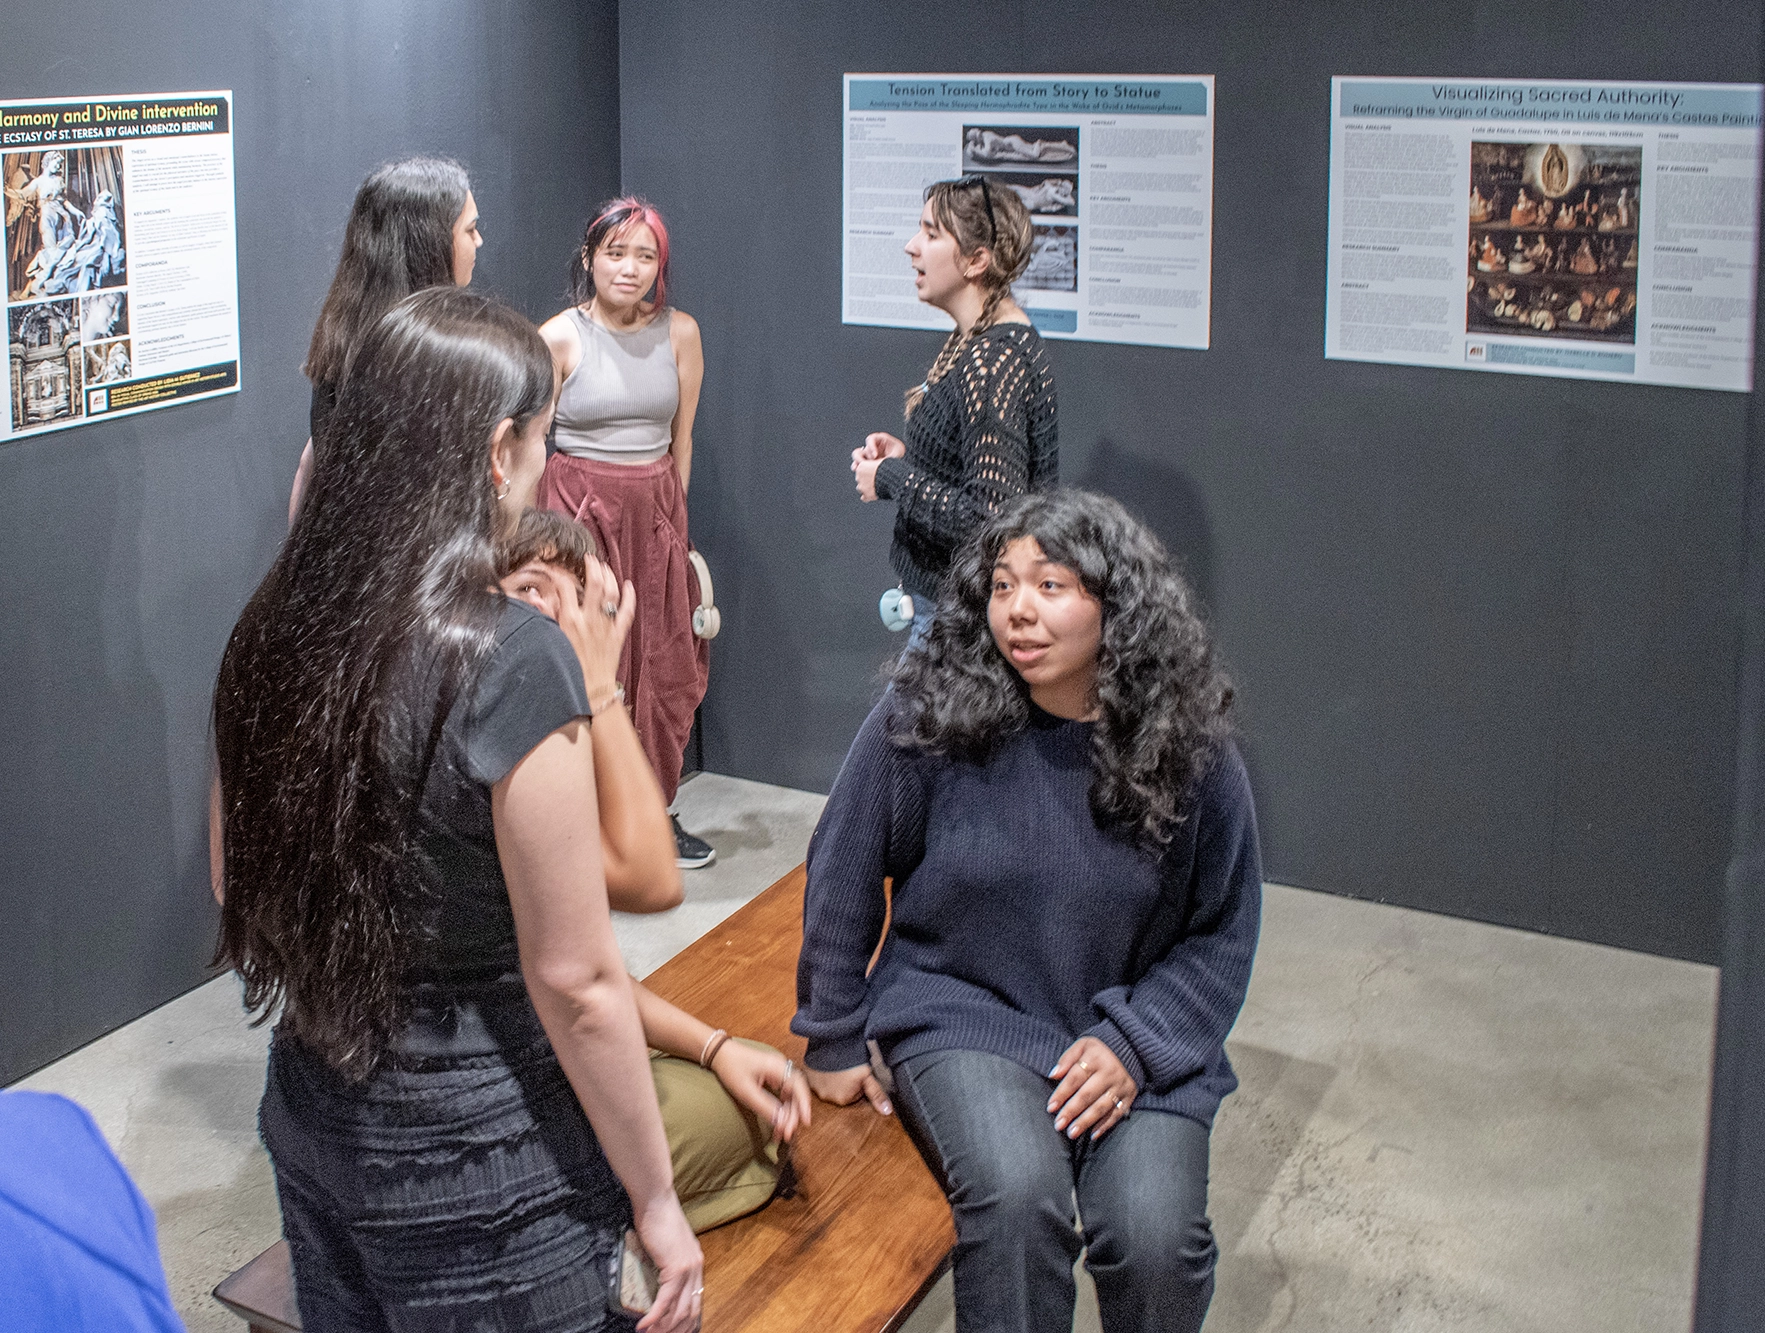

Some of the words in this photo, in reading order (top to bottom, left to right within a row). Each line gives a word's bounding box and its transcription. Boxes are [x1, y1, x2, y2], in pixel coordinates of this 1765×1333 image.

[888, 83, 935, 96] Tension
[941, 82, 1010, 96] Translated
[1016, 83, 1047, 97] from
[1053, 84, 1089, 100] Story
[1095, 86, 1108, 98] to
[1114, 84, 1161, 98] Statue
[1432, 85, 1523, 105] Visualizing
[1528, 87, 1592, 103] Sacred
[0, 110, 59, 129] armony
[63, 104, 91, 124] and
[95, 104, 138, 122] Divine
[142, 102, 218, 120] intervention
[1353, 104, 1413, 118] Reframing
[1416, 105, 1435, 116] the
[1439, 106, 1473, 118] Virgin
[1476, 106, 1487, 117] of
[1490, 107, 1560, 121] Guadalupe
[1563, 108, 1574, 119] in
[1577, 108, 1600, 120] Luis
[1604, 109, 1620, 121] de
[1623, 110, 1669, 123] Mena's
[1672, 112, 1718, 124] Castas
[3, 131, 42, 144] ECSTASY
[44, 130, 57, 141] OF
[59, 129, 71, 140] ST.
[72, 127, 104, 139] TERESA
[105, 126, 117, 137] BY
[118, 125, 139, 136] GIAN
[140, 122, 180, 135] LORENZO
[182, 121, 214, 132] BERNINI
[143, 208, 171, 216] ARGUMENTS
